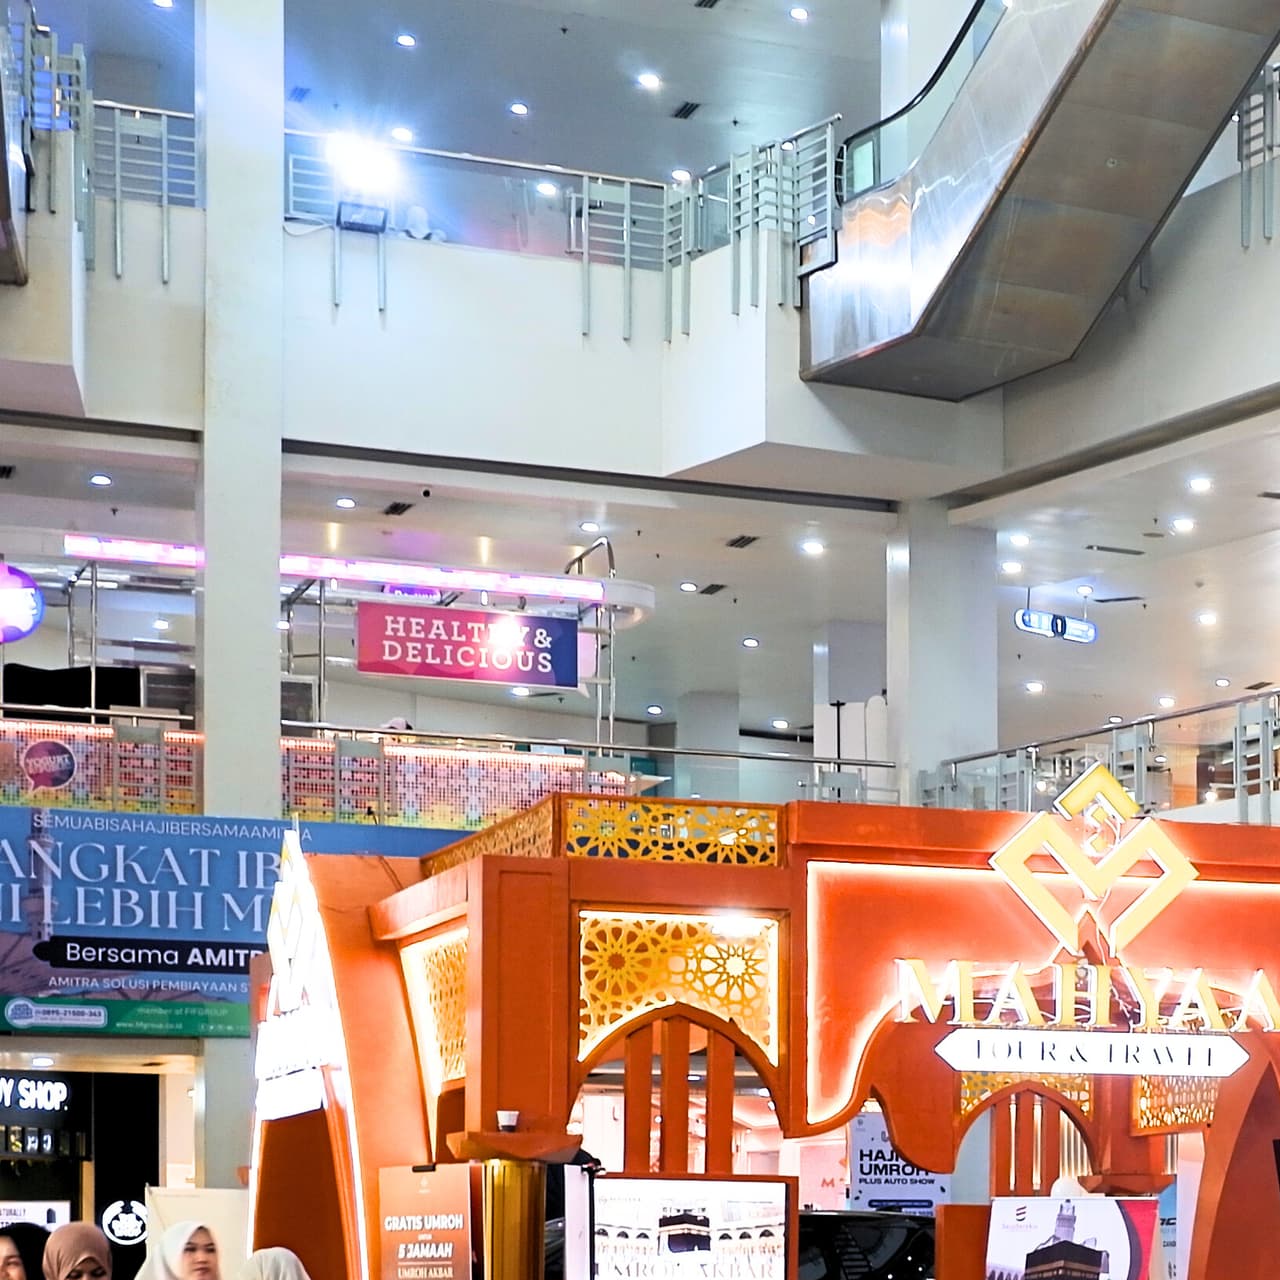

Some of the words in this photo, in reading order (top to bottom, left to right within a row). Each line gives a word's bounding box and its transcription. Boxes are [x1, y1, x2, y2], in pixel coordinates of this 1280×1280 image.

[384, 615, 529, 647] HEALTY
[533, 628, 552, 649] &
[382, 640, 552, 673] DELICIOUS
[33, 813, 312, 842] SEMUABISAHAJIBERSAMAAMIA
[42, 884, 203, 931] LEBIH
[66, 942, 179, 967] Bersama
[48, 975, 99, 989] AMITRA
[102, 977, 149, 991] SOLUSI
[152, 978, 236, 993] PEMBIAYAAN
[384, 1215, 423, 1231] GRATIS
[424, 1214, 464, 1230] UMROH
[406, 1243, 453, 1259] JAMAAH
